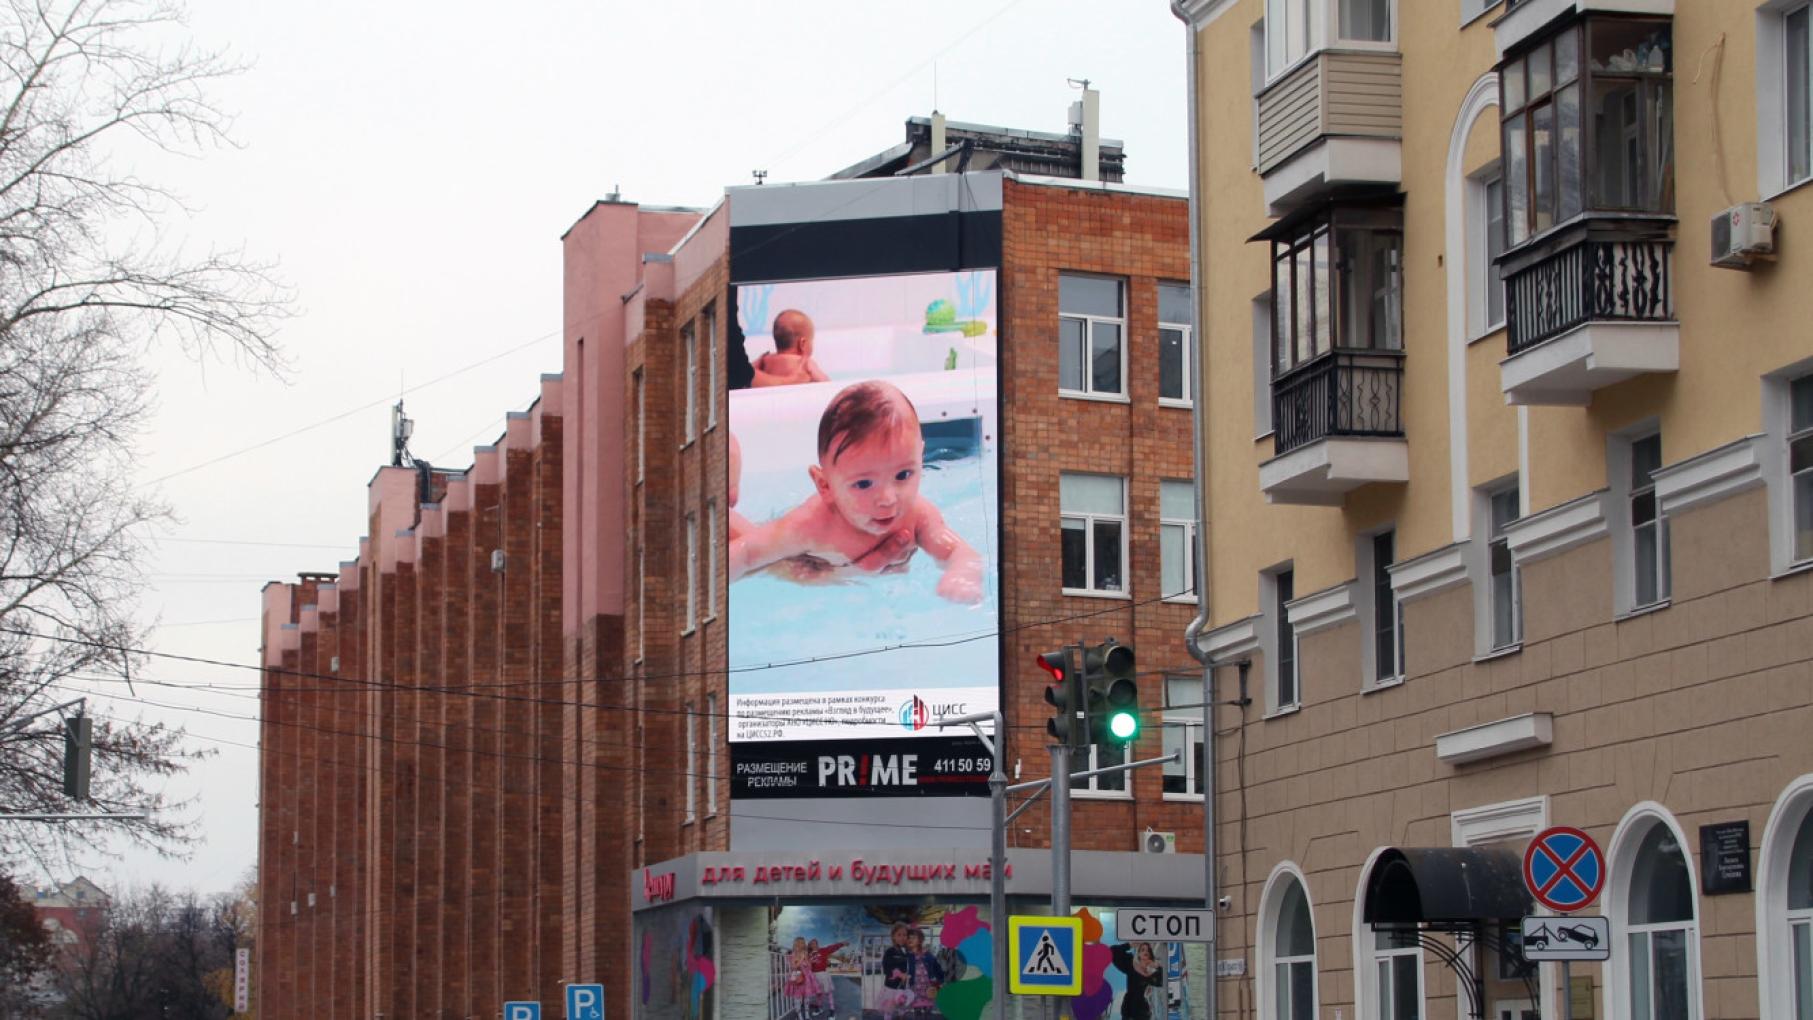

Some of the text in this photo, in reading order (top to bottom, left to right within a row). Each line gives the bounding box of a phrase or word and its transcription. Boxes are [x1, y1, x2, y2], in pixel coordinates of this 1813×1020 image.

[933, 703, 967, 717] ЦИСС
[737, 762, 807, 775] РАЗМЕЩЕНИЕ
[934, 758, 991, 773] 411 50 59
[748, 777, 797, 788] РЕКЛАМЫ
[702, 865, 746, 886] для
[753, 861, 821, 884] детей
[830, 865, 843, 881] и
[850, 858, 956, 885] будущих
[1132, 914, 1200, 936] СТОП
